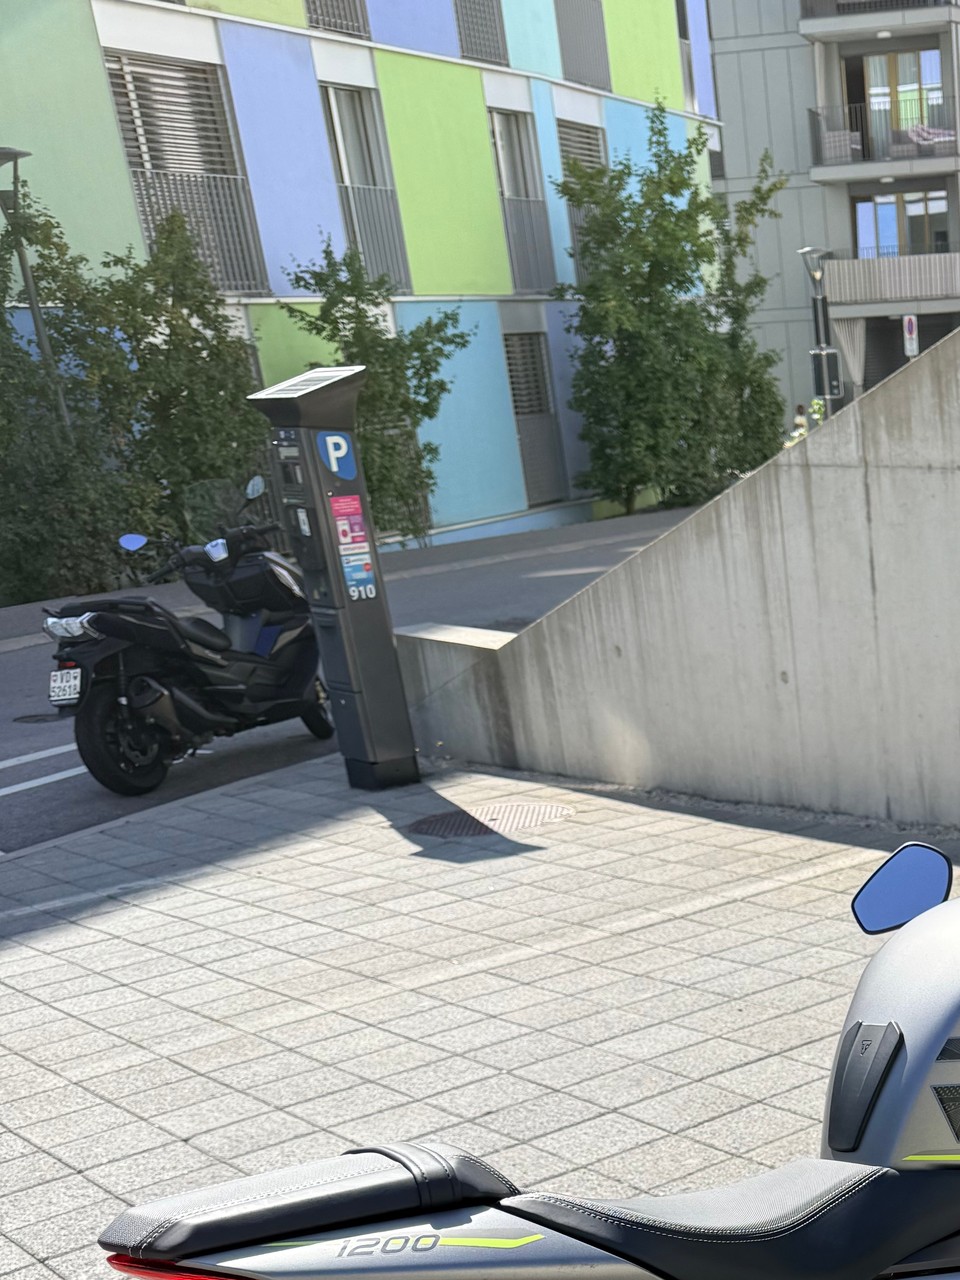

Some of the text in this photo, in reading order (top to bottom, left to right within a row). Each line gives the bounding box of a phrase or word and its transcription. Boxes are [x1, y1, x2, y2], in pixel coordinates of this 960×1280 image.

[325, 435, 348, 472] P
[349, 584, 376, 600] 910
[60, 671, 71, 683] VD
[337, 1234, 440, 1257] 1200
